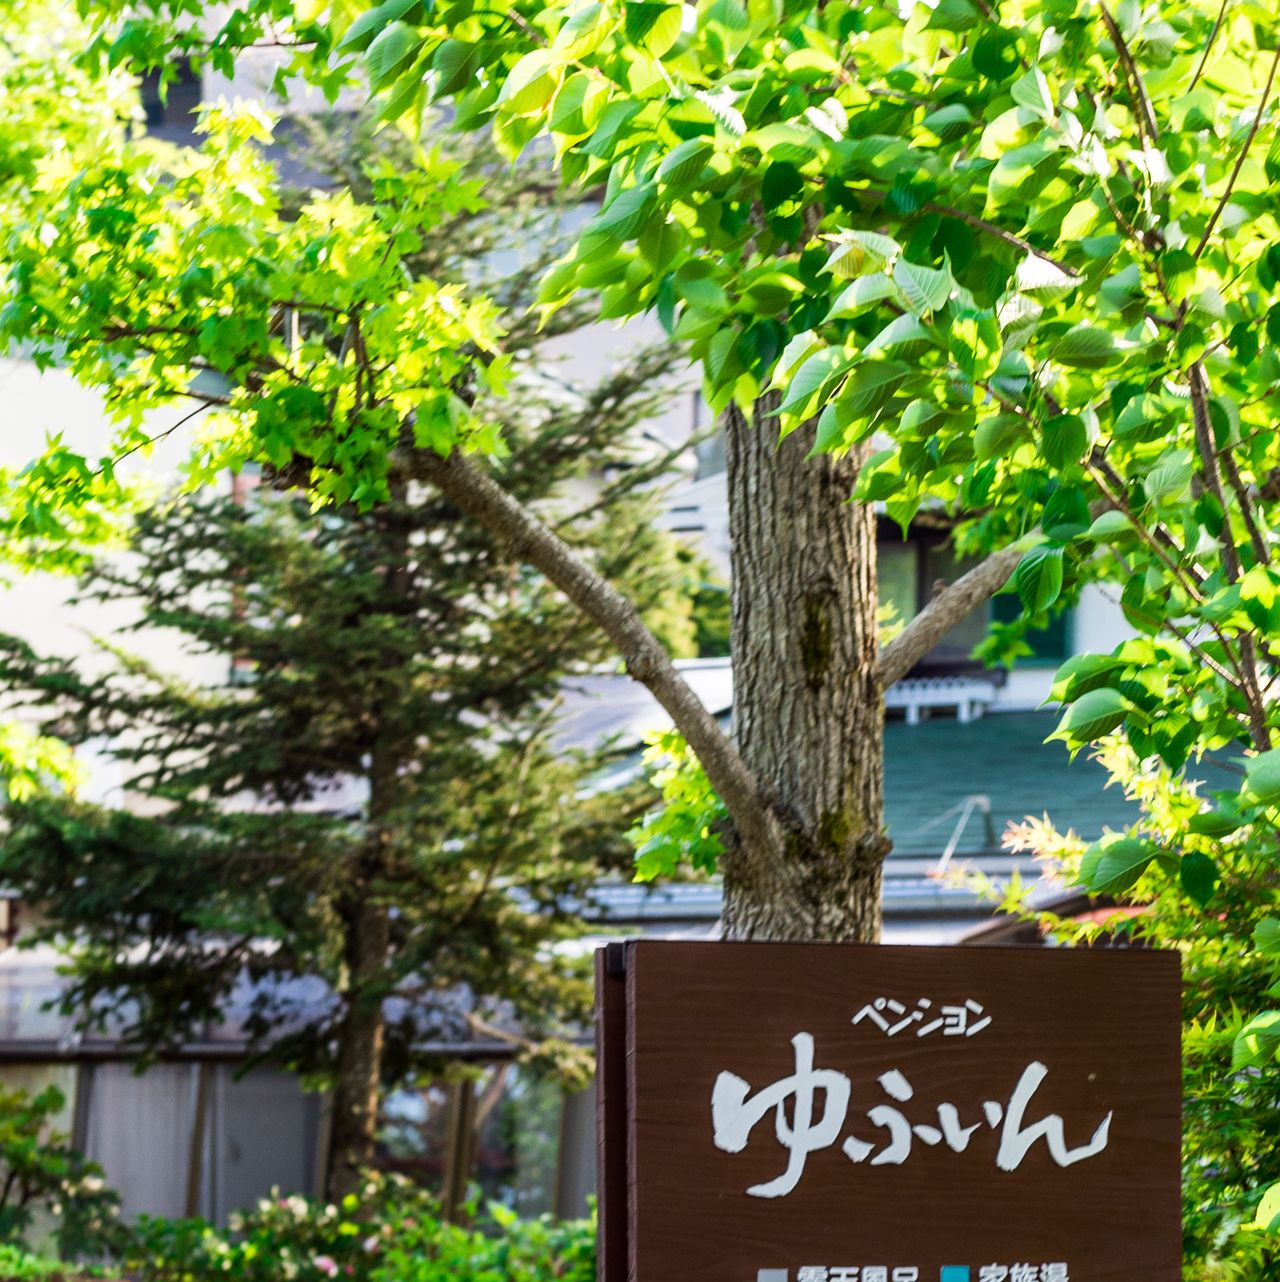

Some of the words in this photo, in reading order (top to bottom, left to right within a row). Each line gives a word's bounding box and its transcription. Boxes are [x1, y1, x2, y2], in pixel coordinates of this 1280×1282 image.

[851, 997, 993, 1038] ペンション
[710, 1031, 1113, 1198] ゆふいん
